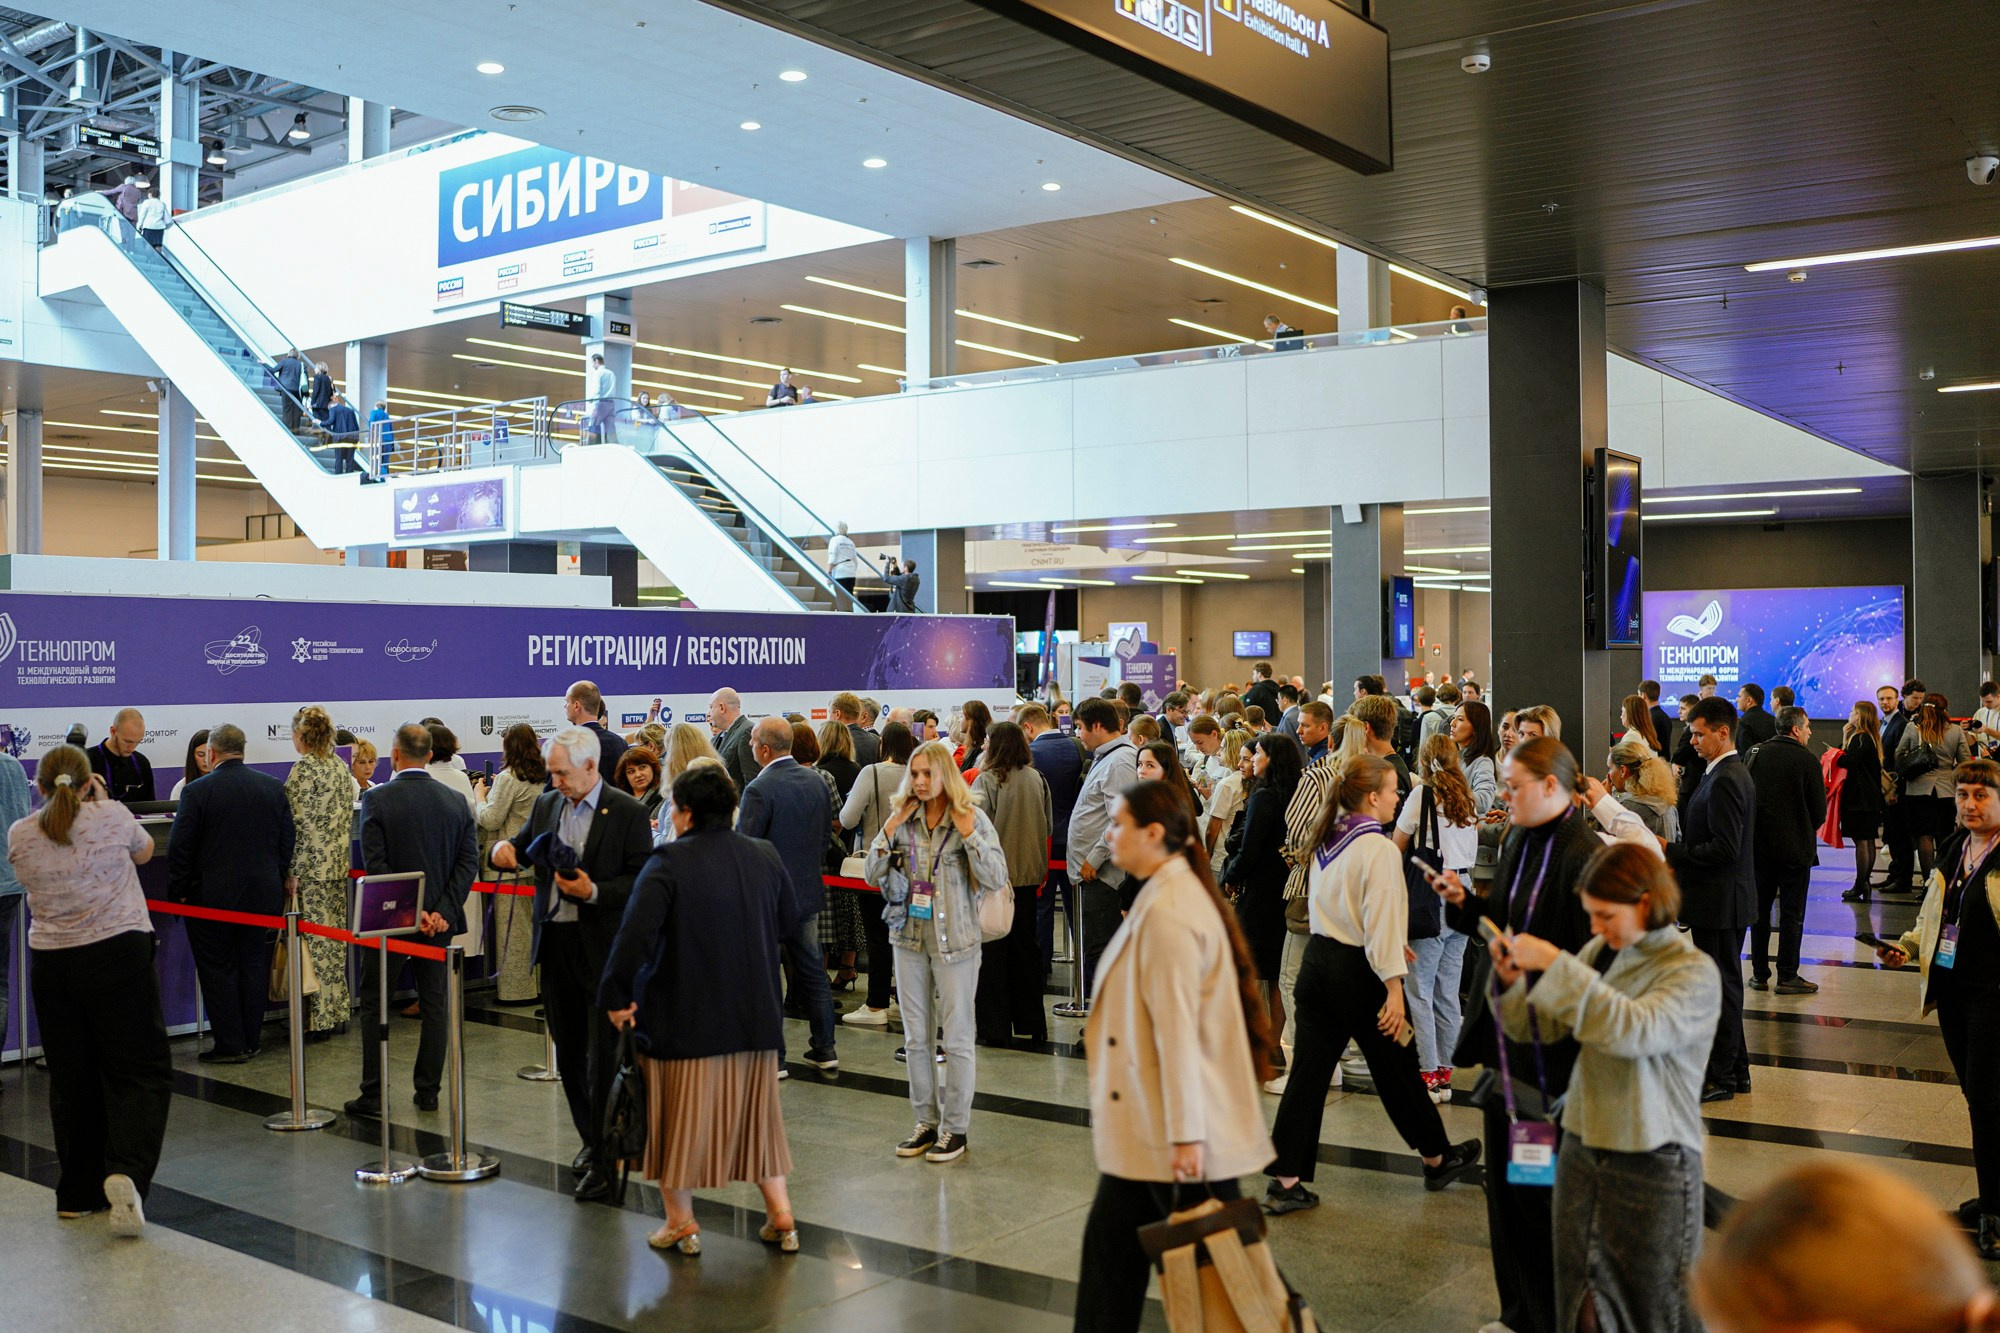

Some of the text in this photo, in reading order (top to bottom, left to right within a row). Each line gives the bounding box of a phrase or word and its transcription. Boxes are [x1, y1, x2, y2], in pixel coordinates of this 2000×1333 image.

[1244, 0, 1316, 41] авильон
[1244, 10, 1309, 58] Exhibition hall A
[438, 278, 463, 291] РОССИЯ
[237, 635, 251, 645] 22
[17, 640, 116, 661] ТЕХНОПРОМ
[528, 635, 806, 670] РЕГИСТРАЦИЯ / REGISTRATION
[1659, 645, 1739, 664] ТЕХНОПРОМ
[17, 665, 116, 676] XI МЕЖДУНАРОДНЫЙ ФОРУМ
[17, 676, 116, 685] ТЕХНОЛОГИЧЕСКОГО РАЗВИТИЯ
[268, 725, 276, 736] N
